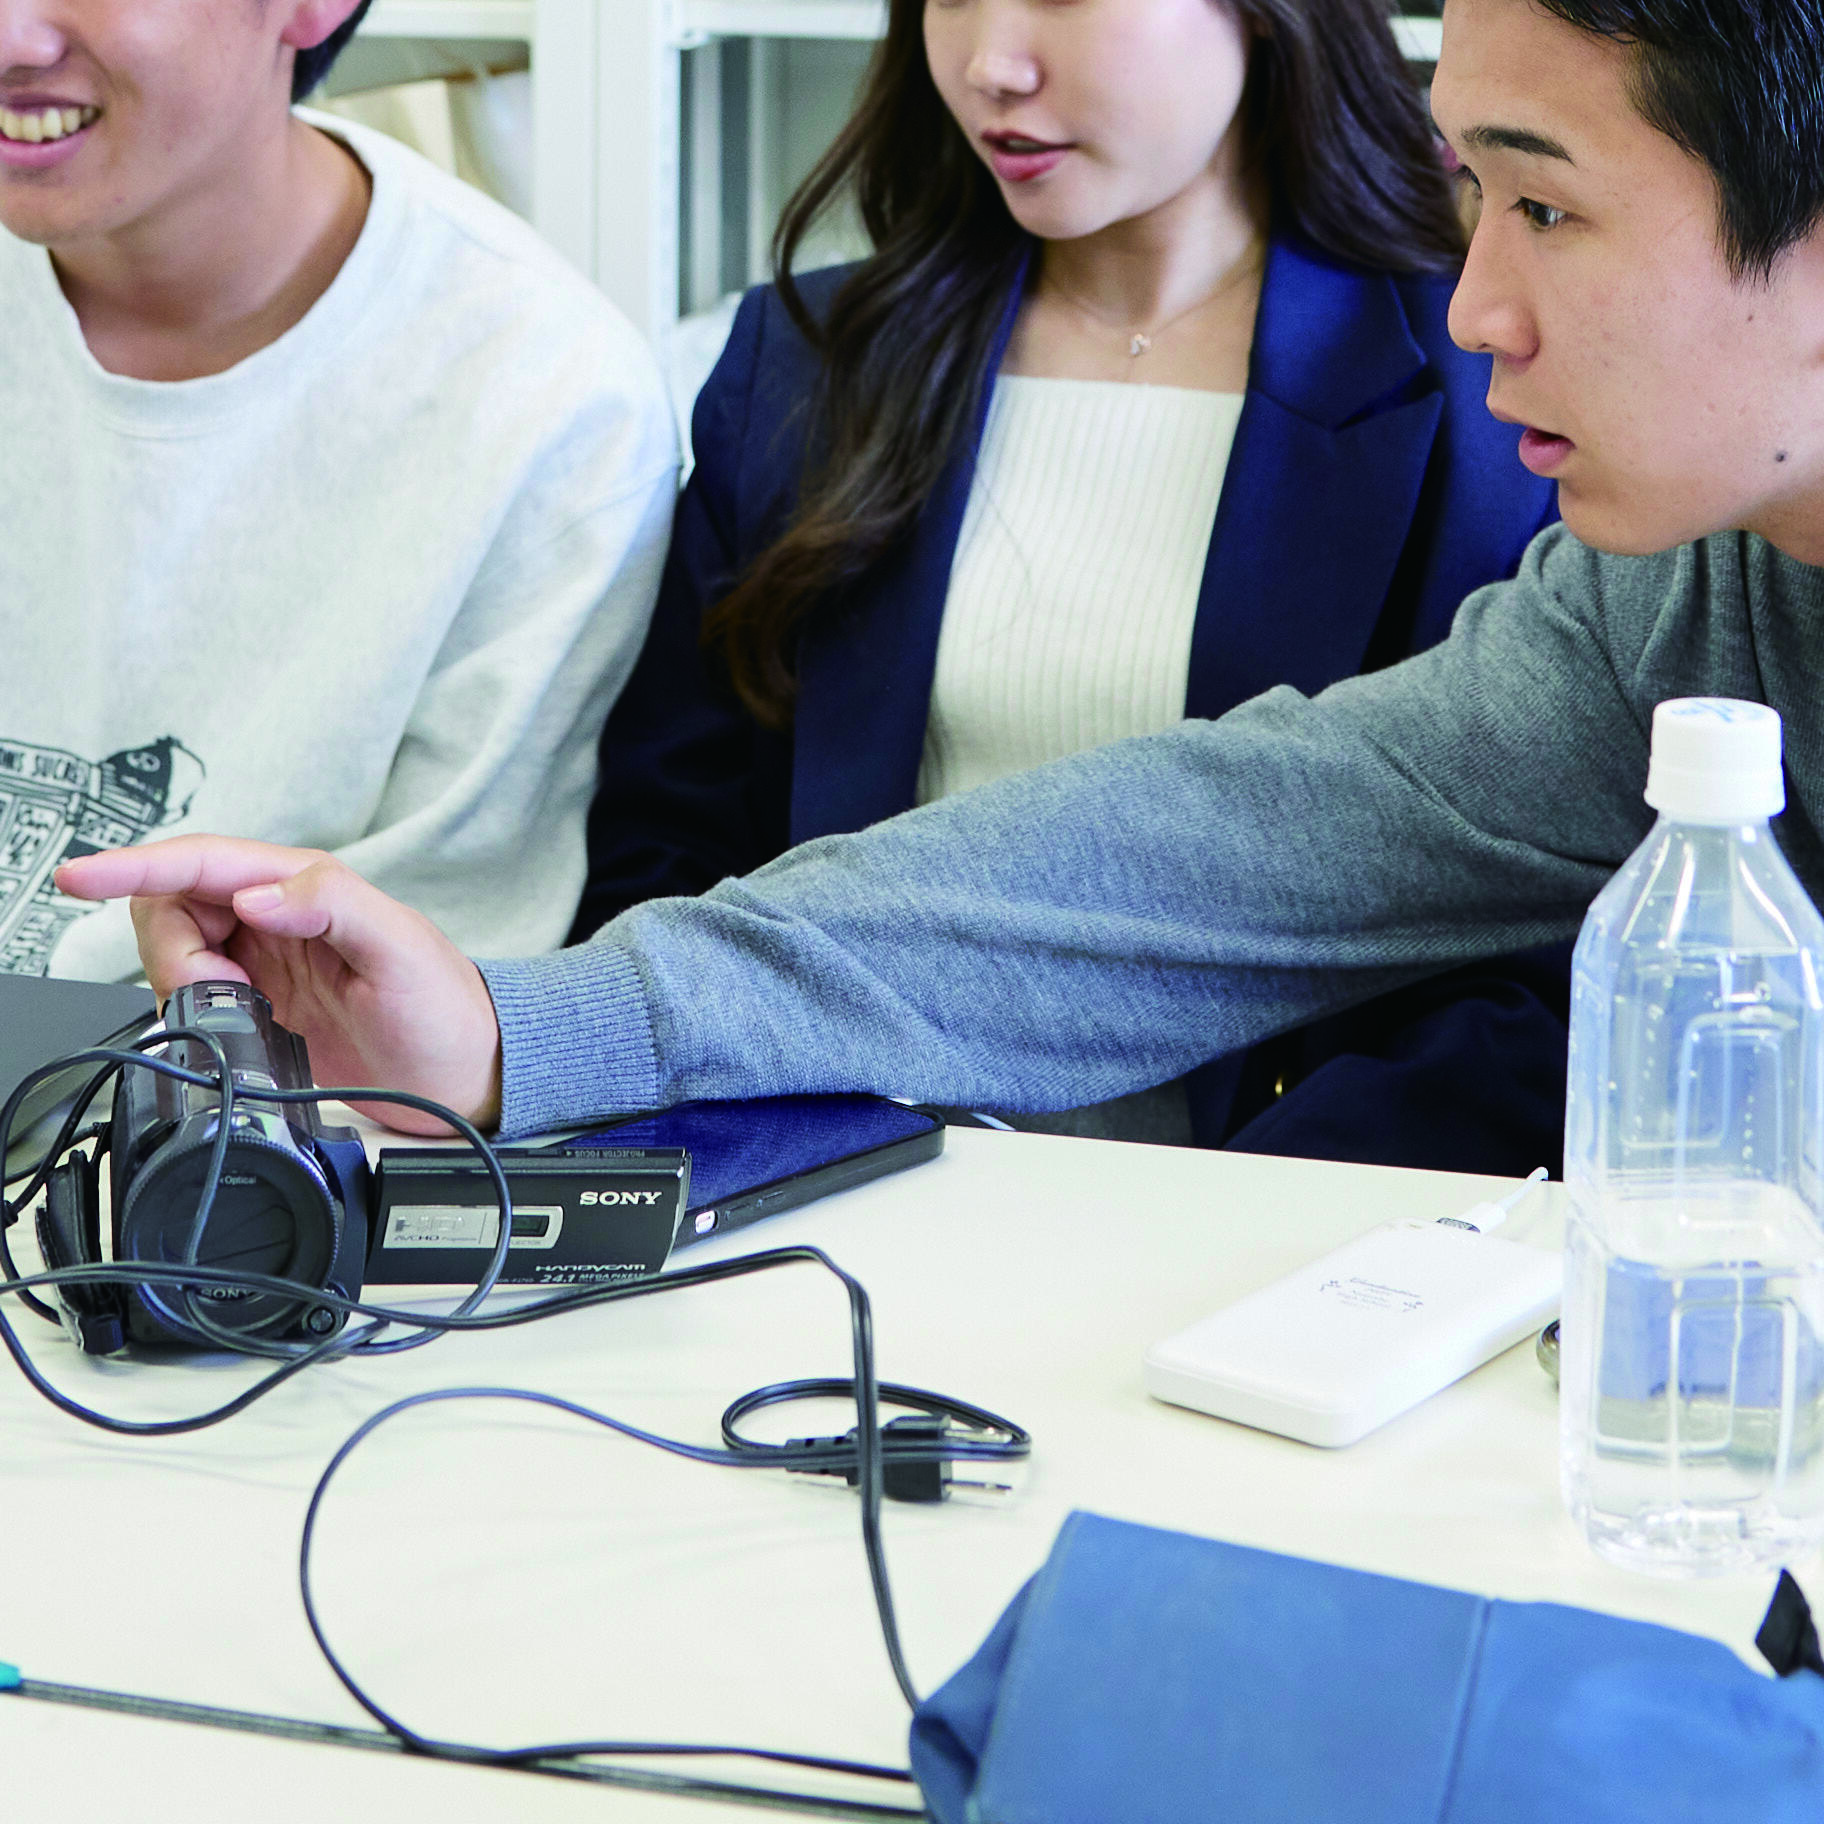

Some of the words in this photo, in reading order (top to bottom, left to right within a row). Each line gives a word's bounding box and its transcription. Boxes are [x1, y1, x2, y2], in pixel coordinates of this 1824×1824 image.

[575, 1149, 601, 1159] FOCUS
[603, 1149, 646, 1159] PROJECTOR
[224, 1175, 257, 1186] Optical
[579, 1190, 663, 1206] SONY
[535, 1263, 646, 1272] HANDYCAM
[539, 1272, 576, 1285] 24.1
[578, 1273, 609, 1283] MEGA
